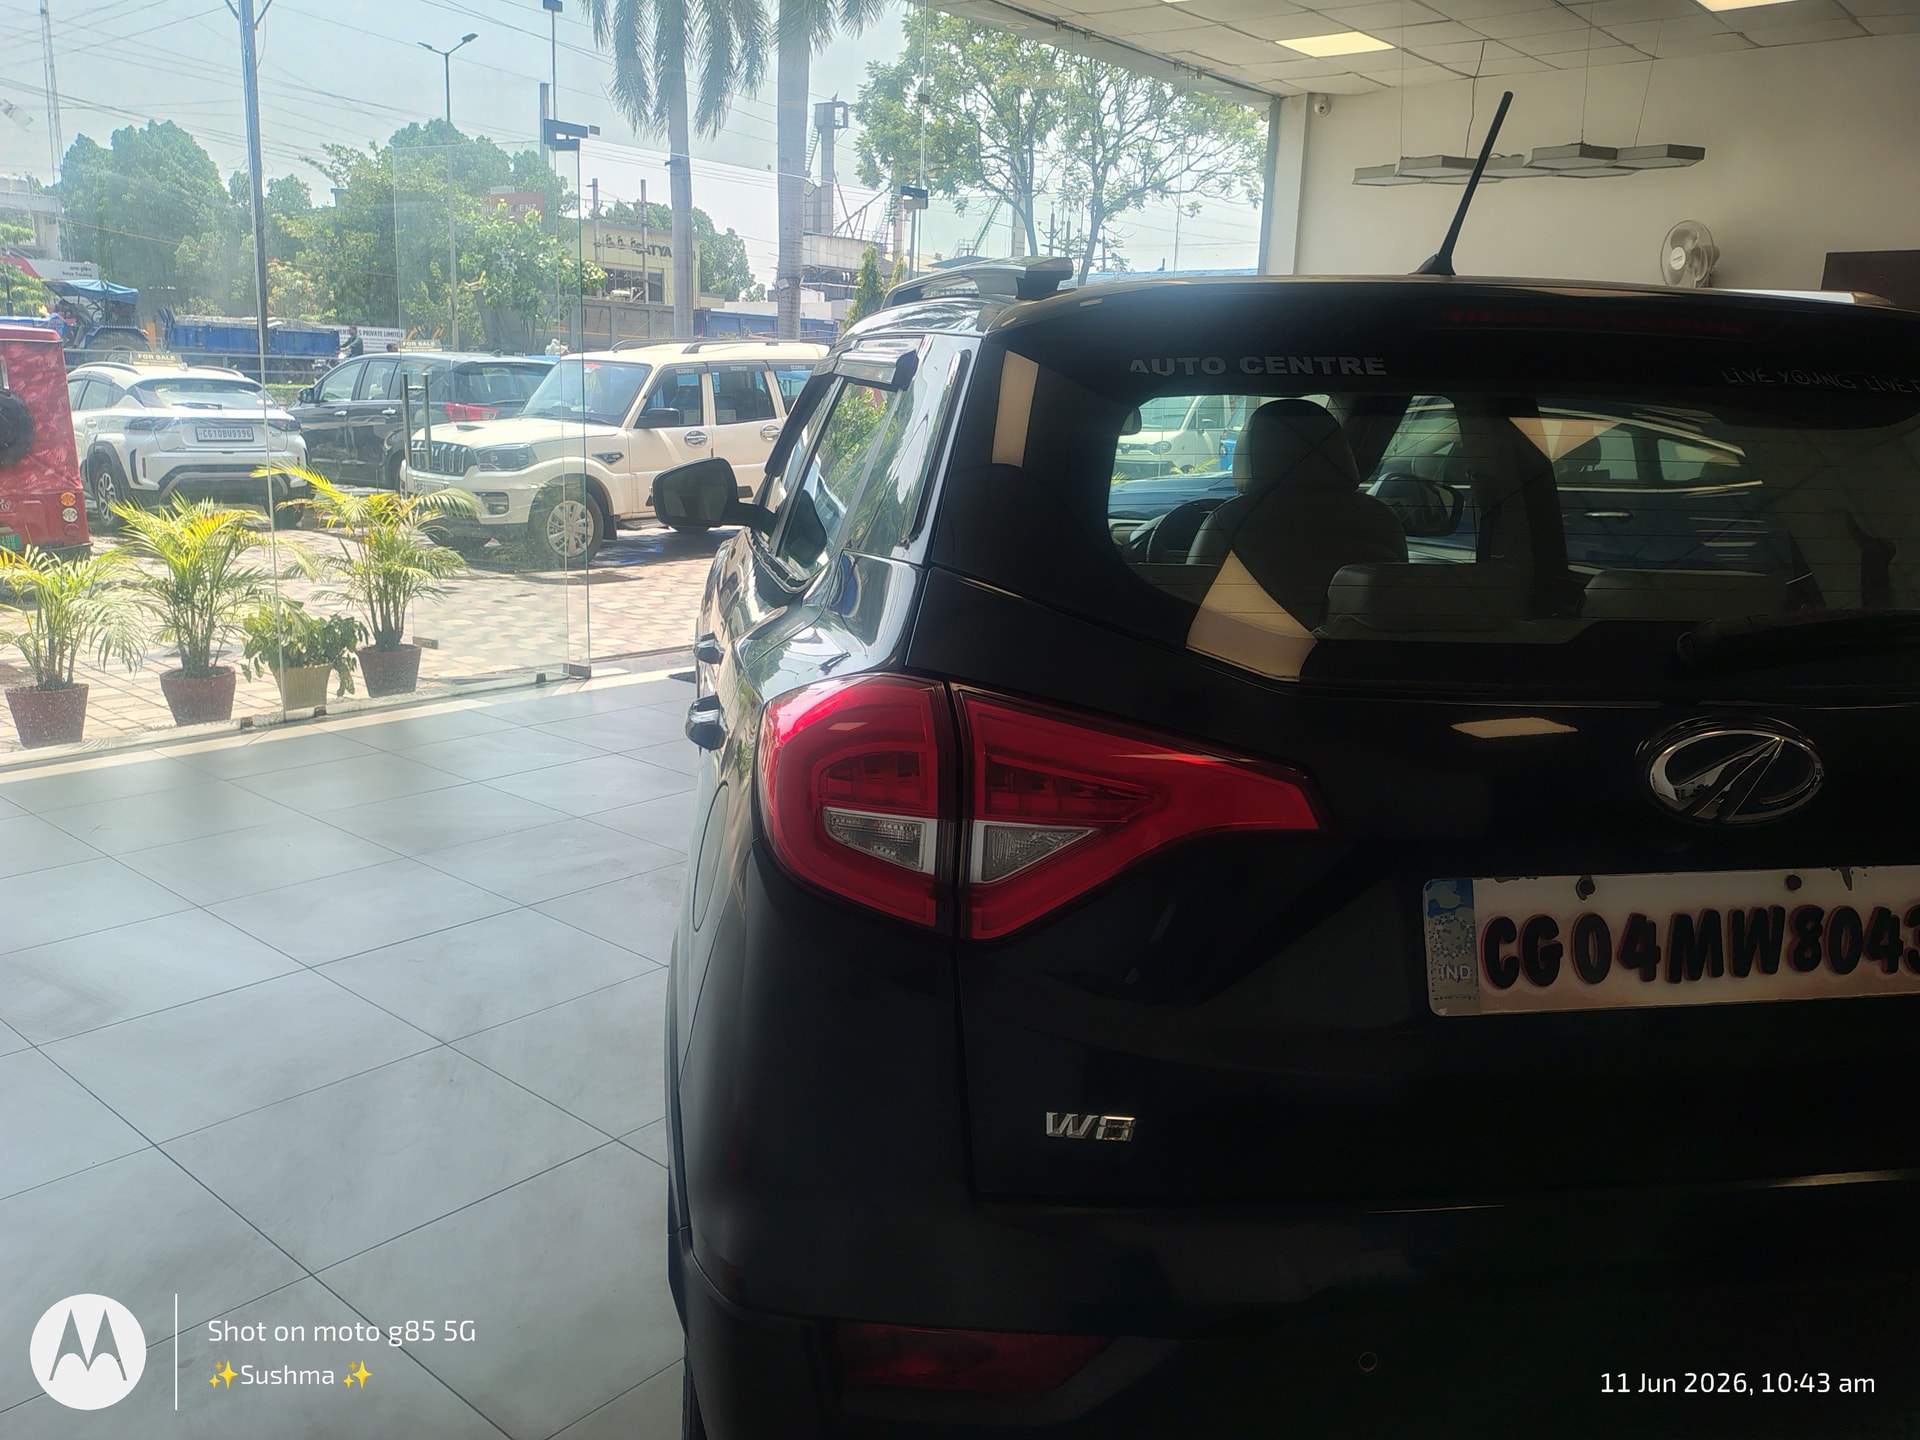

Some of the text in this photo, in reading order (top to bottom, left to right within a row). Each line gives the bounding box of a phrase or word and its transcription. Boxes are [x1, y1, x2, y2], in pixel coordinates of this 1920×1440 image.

[362, 329, 383, 337] PRIVATE
[1129, 355, 1388, 376] AUTO CENTRE
[1440, 964, 1471, 983] IND
